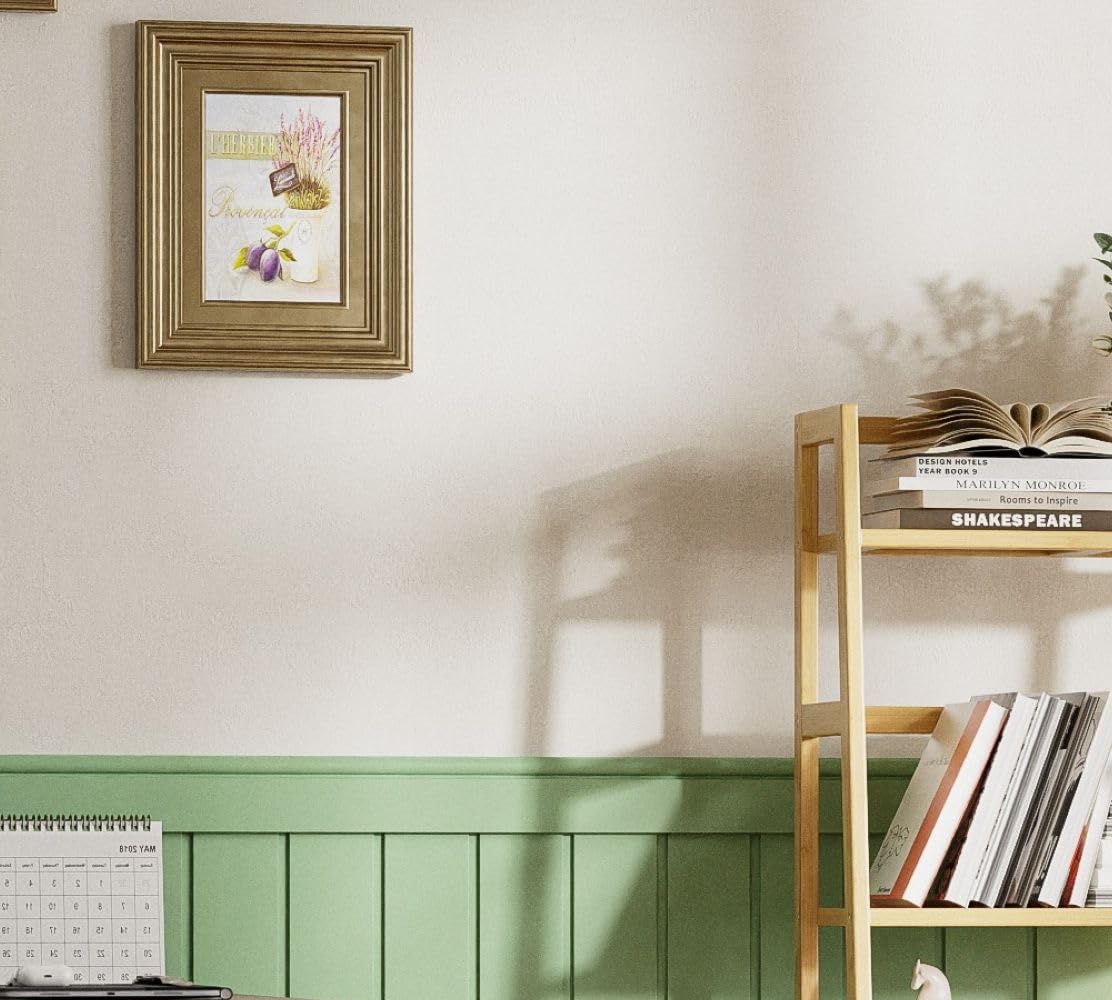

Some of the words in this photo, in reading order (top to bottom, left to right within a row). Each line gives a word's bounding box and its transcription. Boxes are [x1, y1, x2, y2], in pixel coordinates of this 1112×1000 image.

[918, 458, 951, 466] DESIGN
[954, 458, 988, 466] HOTELS
[918, 467, 942, 475] YEAR
[945, 467, 970, 475] BOOK
[972, 467, 978, 475] 9
[956, 479, 1021, 489] MARILYN
[1025, 480, 1086, 490] MONROE
[999, 495, 1031, 505] Rooms
[1033, 496, 1044, 505] to
[1046, 496, 1079, 507] Inspire
[951, 513, 1082, 528] SHAKESPEARE
